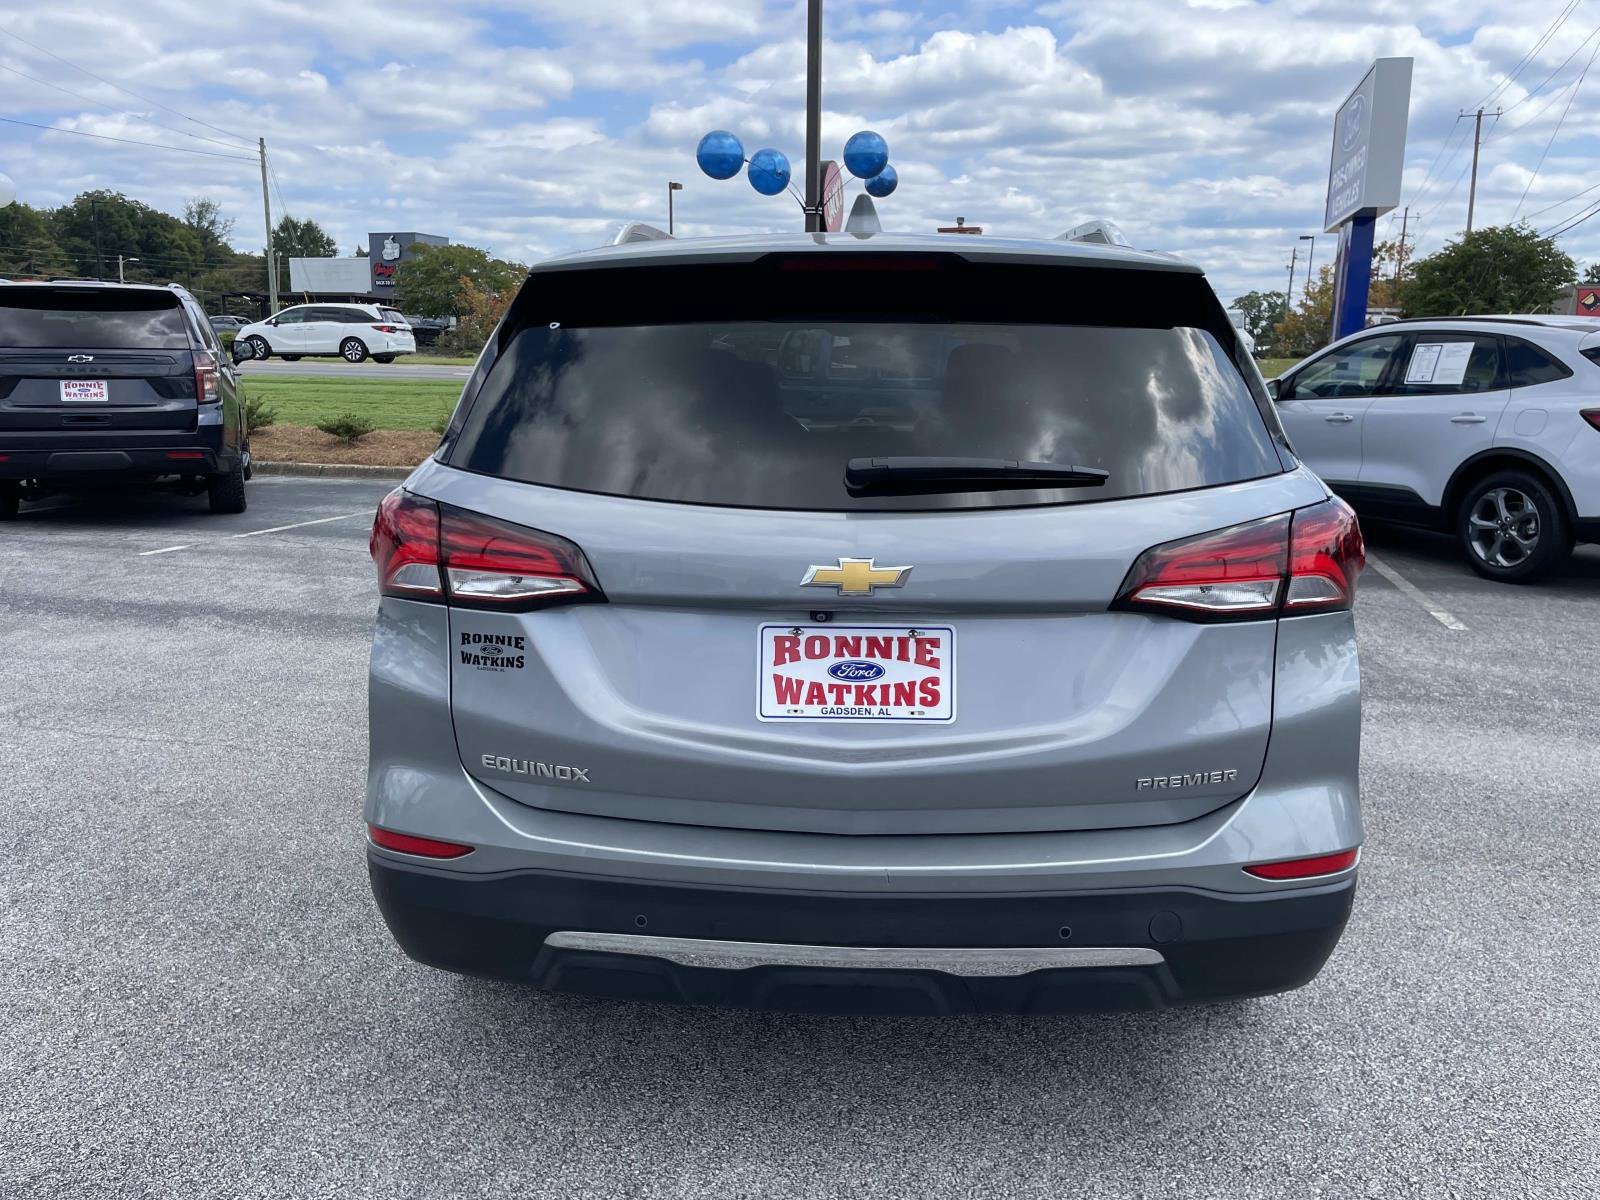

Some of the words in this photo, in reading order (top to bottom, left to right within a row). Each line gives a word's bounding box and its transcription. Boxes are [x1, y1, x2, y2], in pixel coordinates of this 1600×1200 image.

[64, 382, 104, 390] RONNIE
[460, 632, 525, 651] RONNIE
[460, 650, 525, 669] WATKINS
[773, 635, 941, 670] RONNIE
[836, 663, 878, 678] Ford
[772, 673, 941, 708] WATKINS
[820, 706, 875, 717] GADSDEN,
[878, 707, 892, 716] AL
[481, 754, 591, 783] EQUINOX
[1136, 769, 1238, 791] PREMIER
